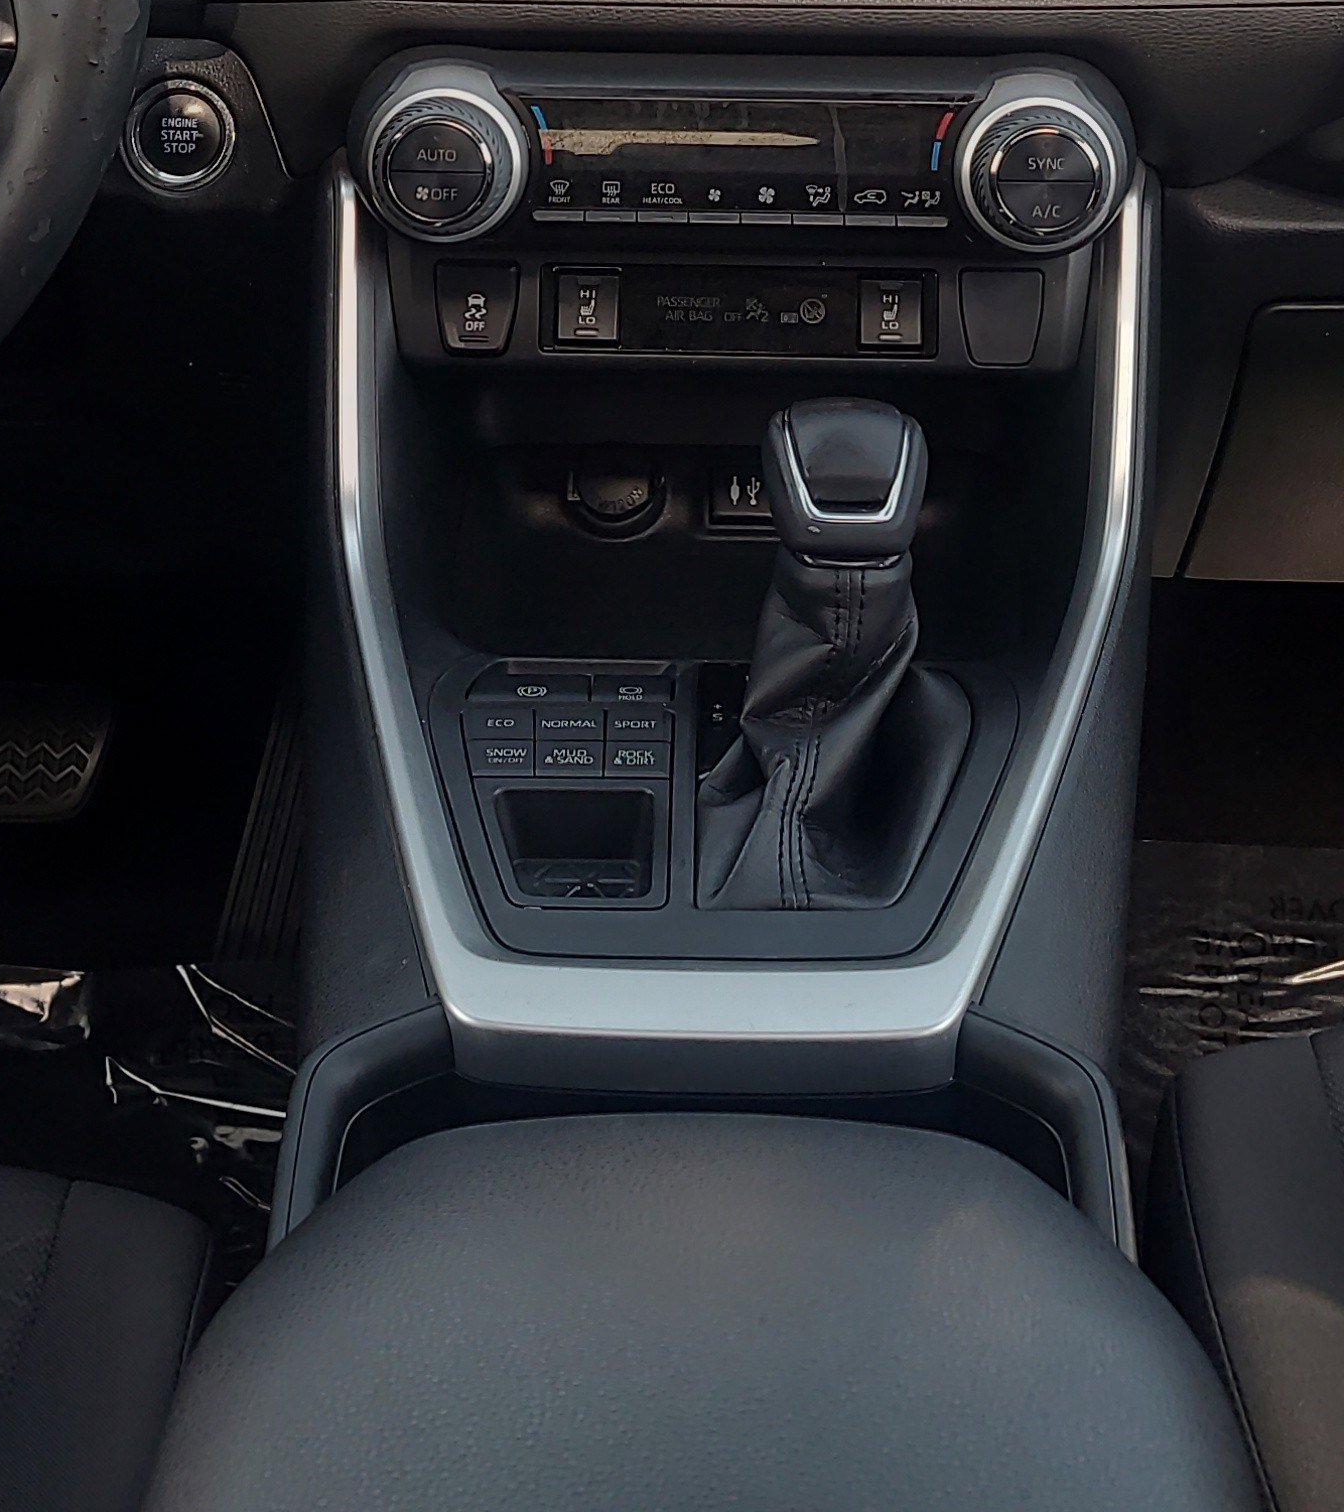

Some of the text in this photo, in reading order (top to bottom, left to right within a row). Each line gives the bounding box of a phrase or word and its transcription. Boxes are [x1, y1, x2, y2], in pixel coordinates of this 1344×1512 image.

[161, 117, 198, 129] ENGINE
[160, 130, 199, 142] START
[163, 142, 197, 154] STOP
[416, 148, 458, 162] AUTO
[1027, 157, 1066, 171] SYNC
[650, 182, 675, 195] ECO
[430, 187, 459, 201] OFF
[548, 196, 571, 204] FRONT
[601, 196, 620, 205] REAR
[642, 197, 683, 205] HEAT/COOL
[1031, 203, 1062, 220] A/C
[579, 290, 597, 299] HI
[882, 294, 899, 304] HI
[656, 295, 722, 309] PASSENGER
[578, 316, 596, 325] LO
[665, 310, 686, 322] AIR
[688, 310, 714, 322] BAG
[464, 321, 486, 332] OFF
[881, 320, 900, 330] LO
[618, 693, 643, 701] HOLD
[486, 719, 515, 728] ECO
[540, 719, 598, 729] NORMAL
[613, 719, 657, 729] SPORT
[485, 748, 528, 758] SNOW
[553, 748, 588, 758] MUD
[617, 749, 654, 759] ROCK
[544, 755, 595, 765] & SAND
[613, 756, 656, 766] & DIRT
